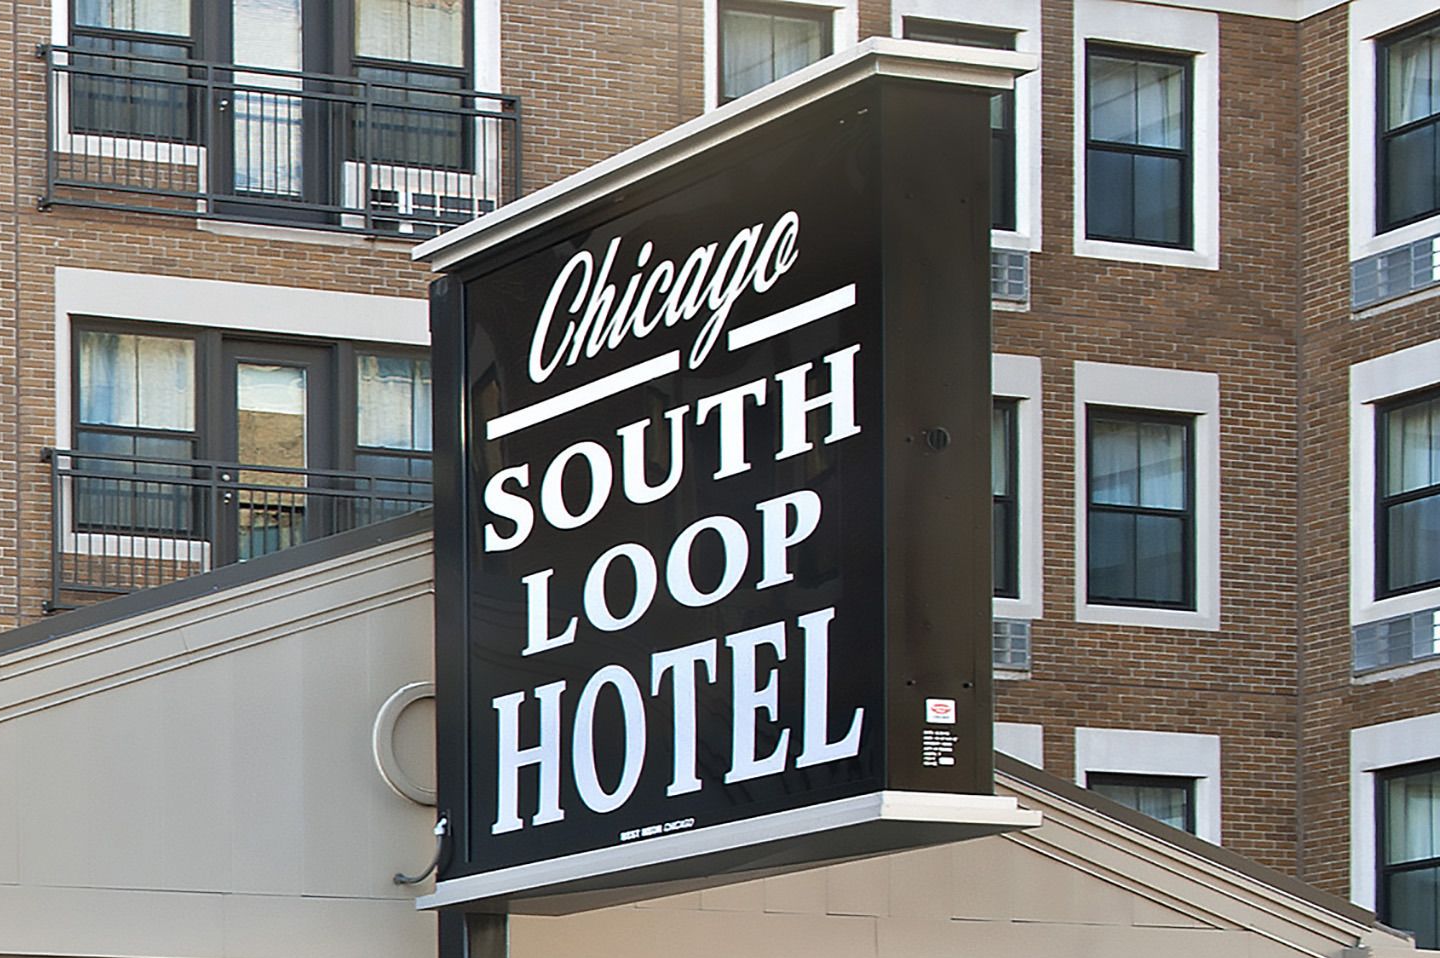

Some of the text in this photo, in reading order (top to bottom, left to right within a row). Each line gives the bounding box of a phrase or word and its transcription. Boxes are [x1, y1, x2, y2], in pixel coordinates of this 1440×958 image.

[528, 210, 799, 384] Chicago
[484, 343, 862, 552] SOUTH
[521, 490, 822, 657] LOOP
[491, 606, 865, 835] HOTEL
